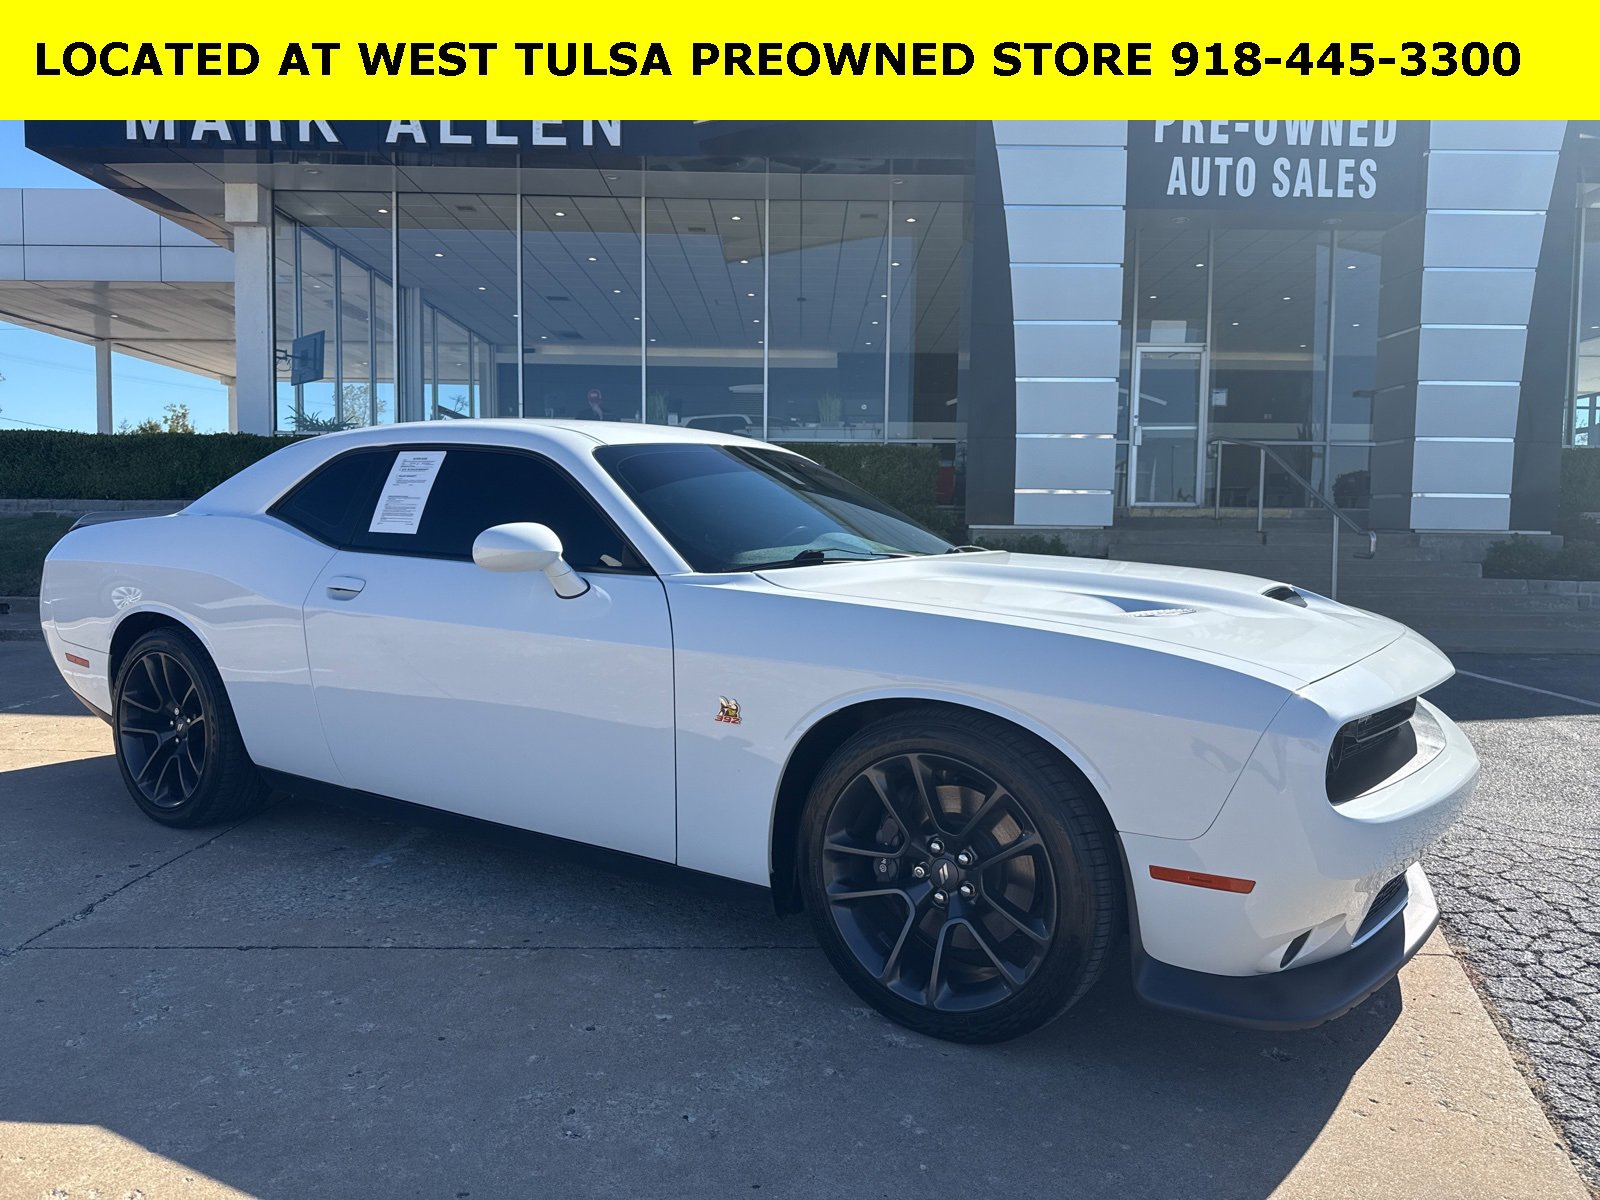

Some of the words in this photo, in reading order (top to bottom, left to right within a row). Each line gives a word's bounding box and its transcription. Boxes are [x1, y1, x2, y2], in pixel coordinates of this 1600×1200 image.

[1166, 156, 1257, 197] AUTO
[1272, 158, 1378, 199] SALES
[715, 715, 742, 724] 392
